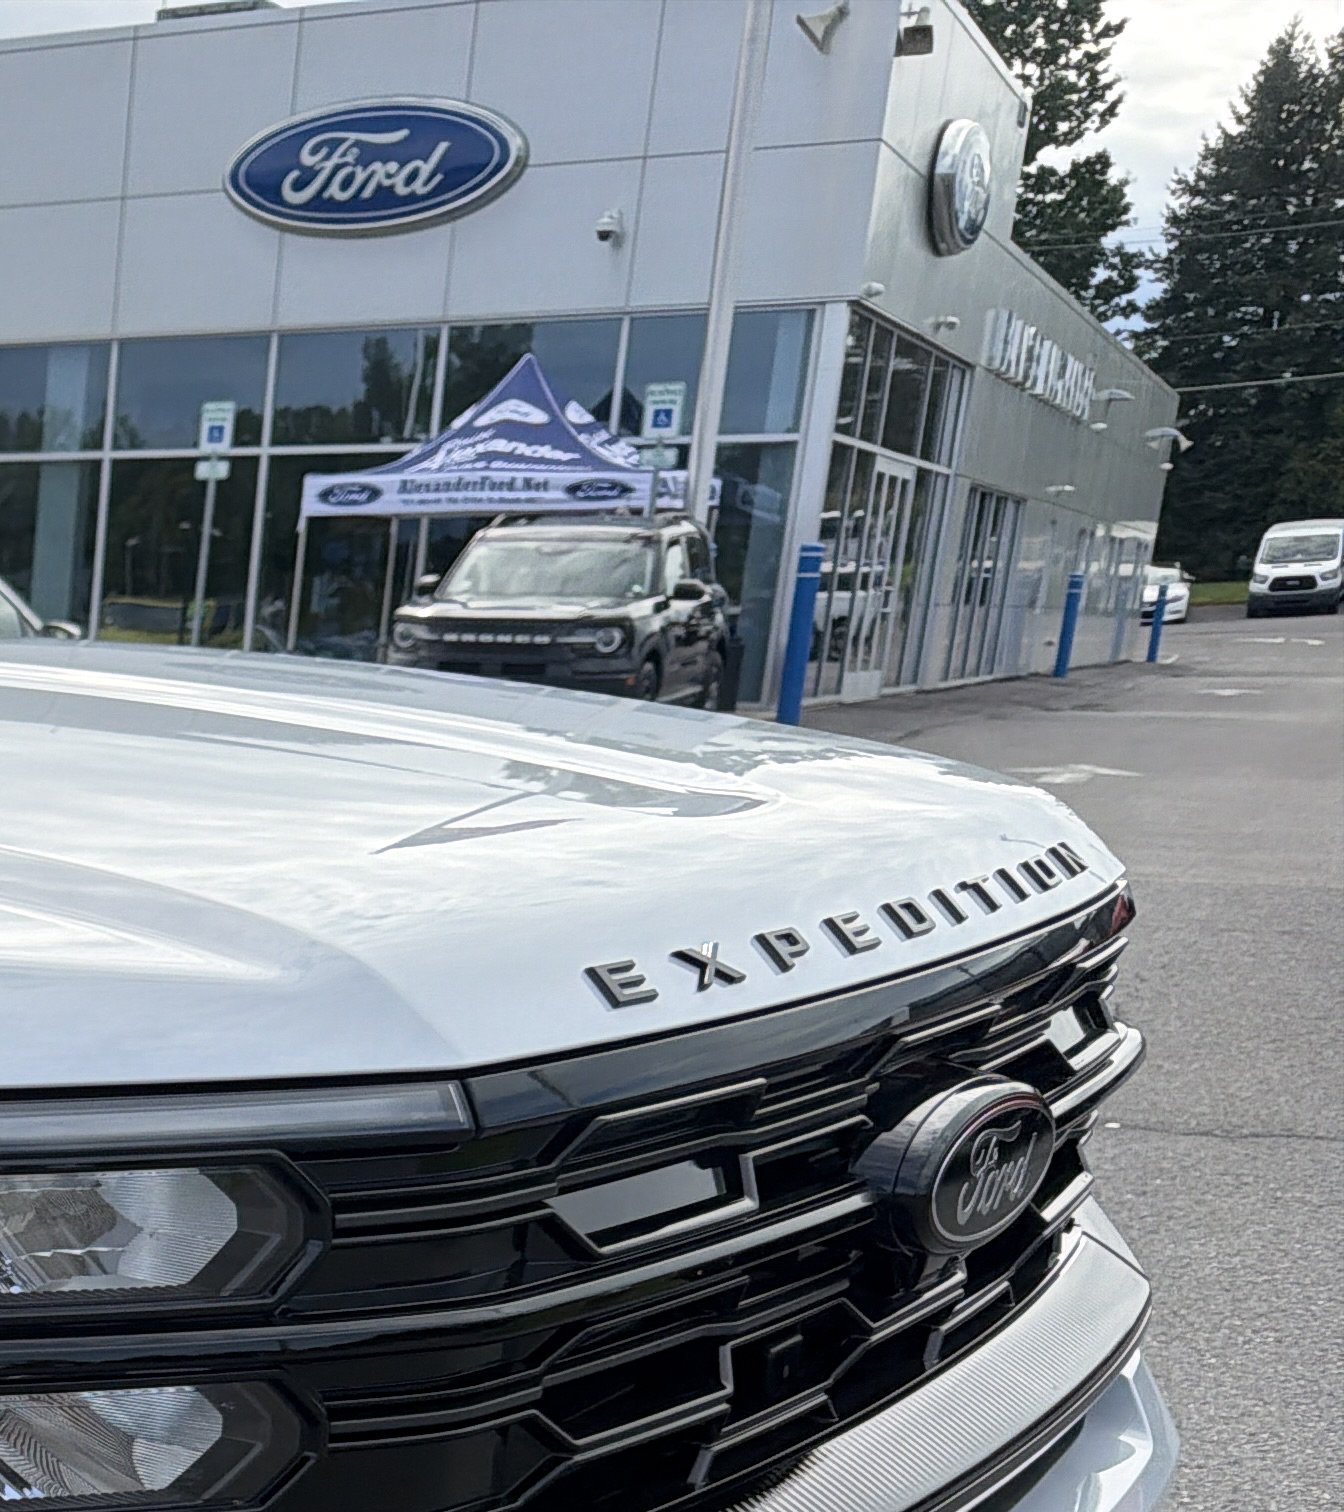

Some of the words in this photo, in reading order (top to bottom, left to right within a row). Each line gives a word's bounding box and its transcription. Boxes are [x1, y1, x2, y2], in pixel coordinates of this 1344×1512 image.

[280, 127, 452, 205] Ford
[581, 841, 1091, 1011] EXPEDITION
[956, 1119, 1038, 1226] Ford
